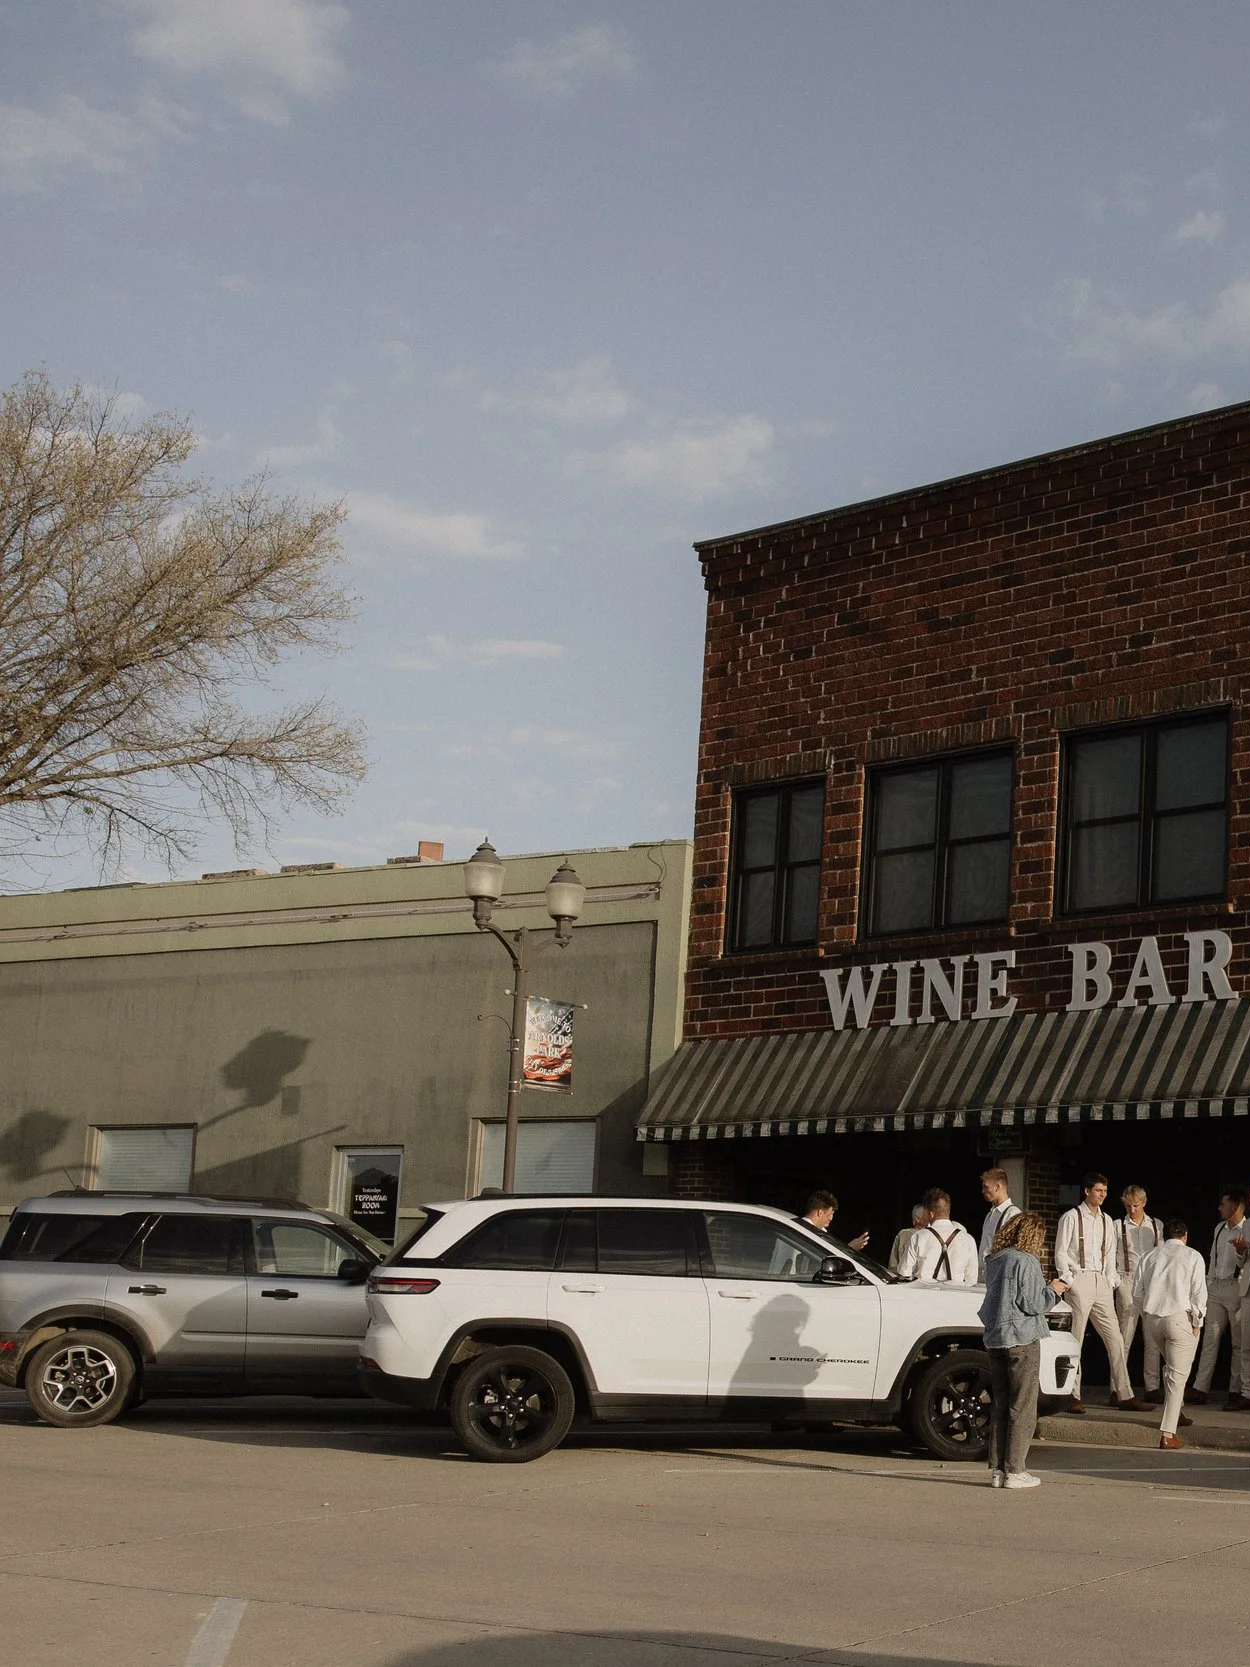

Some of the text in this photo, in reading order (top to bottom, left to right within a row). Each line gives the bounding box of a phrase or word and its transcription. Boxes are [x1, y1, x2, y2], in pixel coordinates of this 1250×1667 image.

[819, 929, 1240, 1031] WINE BAR
[529, 1014, 572, 1033] WELCOME TO
[528, 1030, 570, 1045] ARNOLDS
[536, 1046, 562, 1059] PARK
